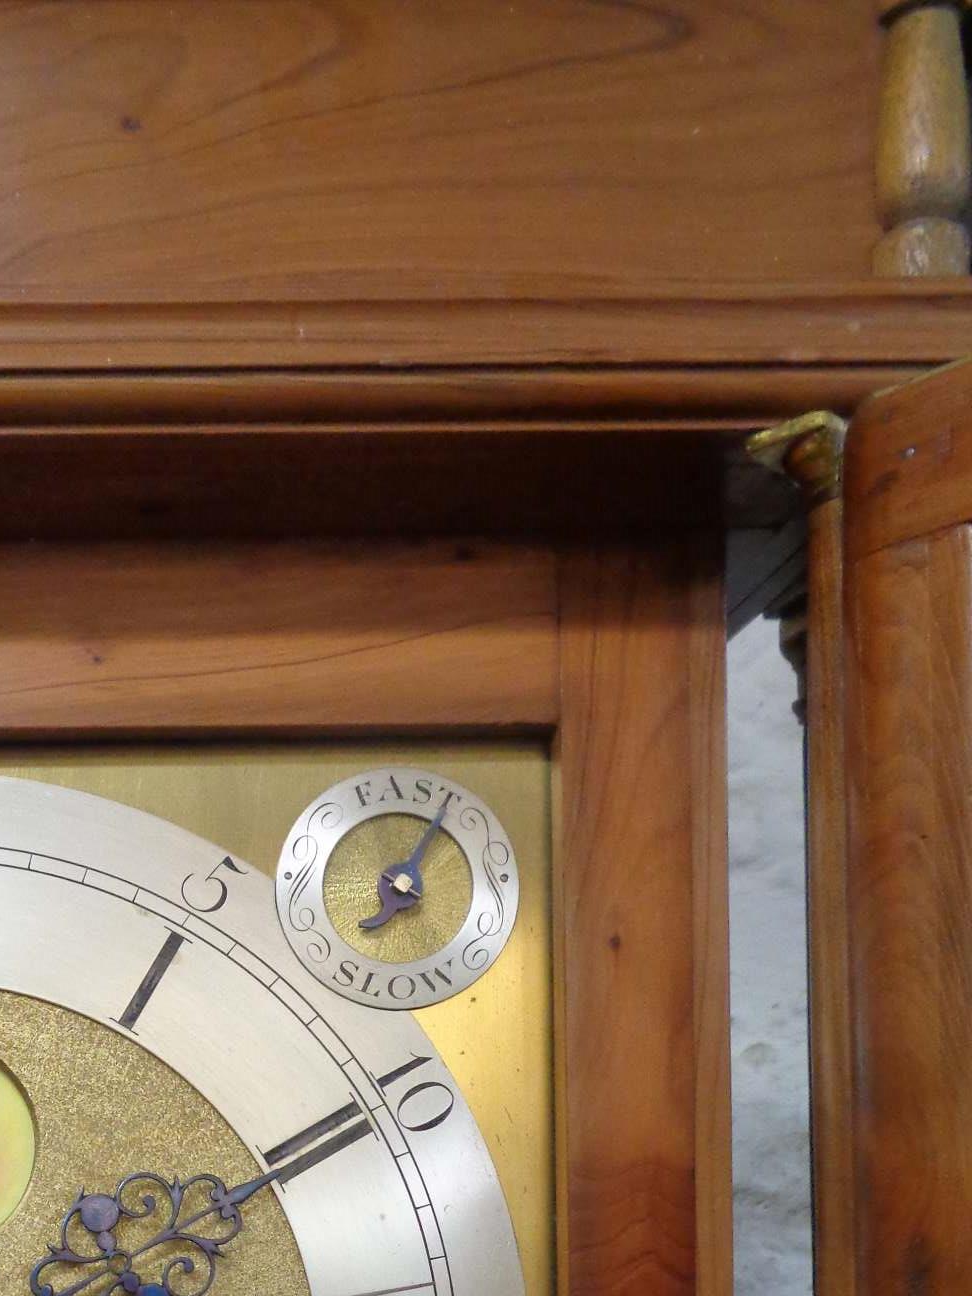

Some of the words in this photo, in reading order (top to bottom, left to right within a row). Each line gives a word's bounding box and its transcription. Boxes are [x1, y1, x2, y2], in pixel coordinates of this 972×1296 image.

[354, 775, 463, 810] FAST
[181, 855, 249, 913] 5
[108, 925, 193, 1036] I
[331, 959, 454, 1000] SLOW
[369, 1050, 455, 1132] 10
[255, 1091, 380, 1193] II
